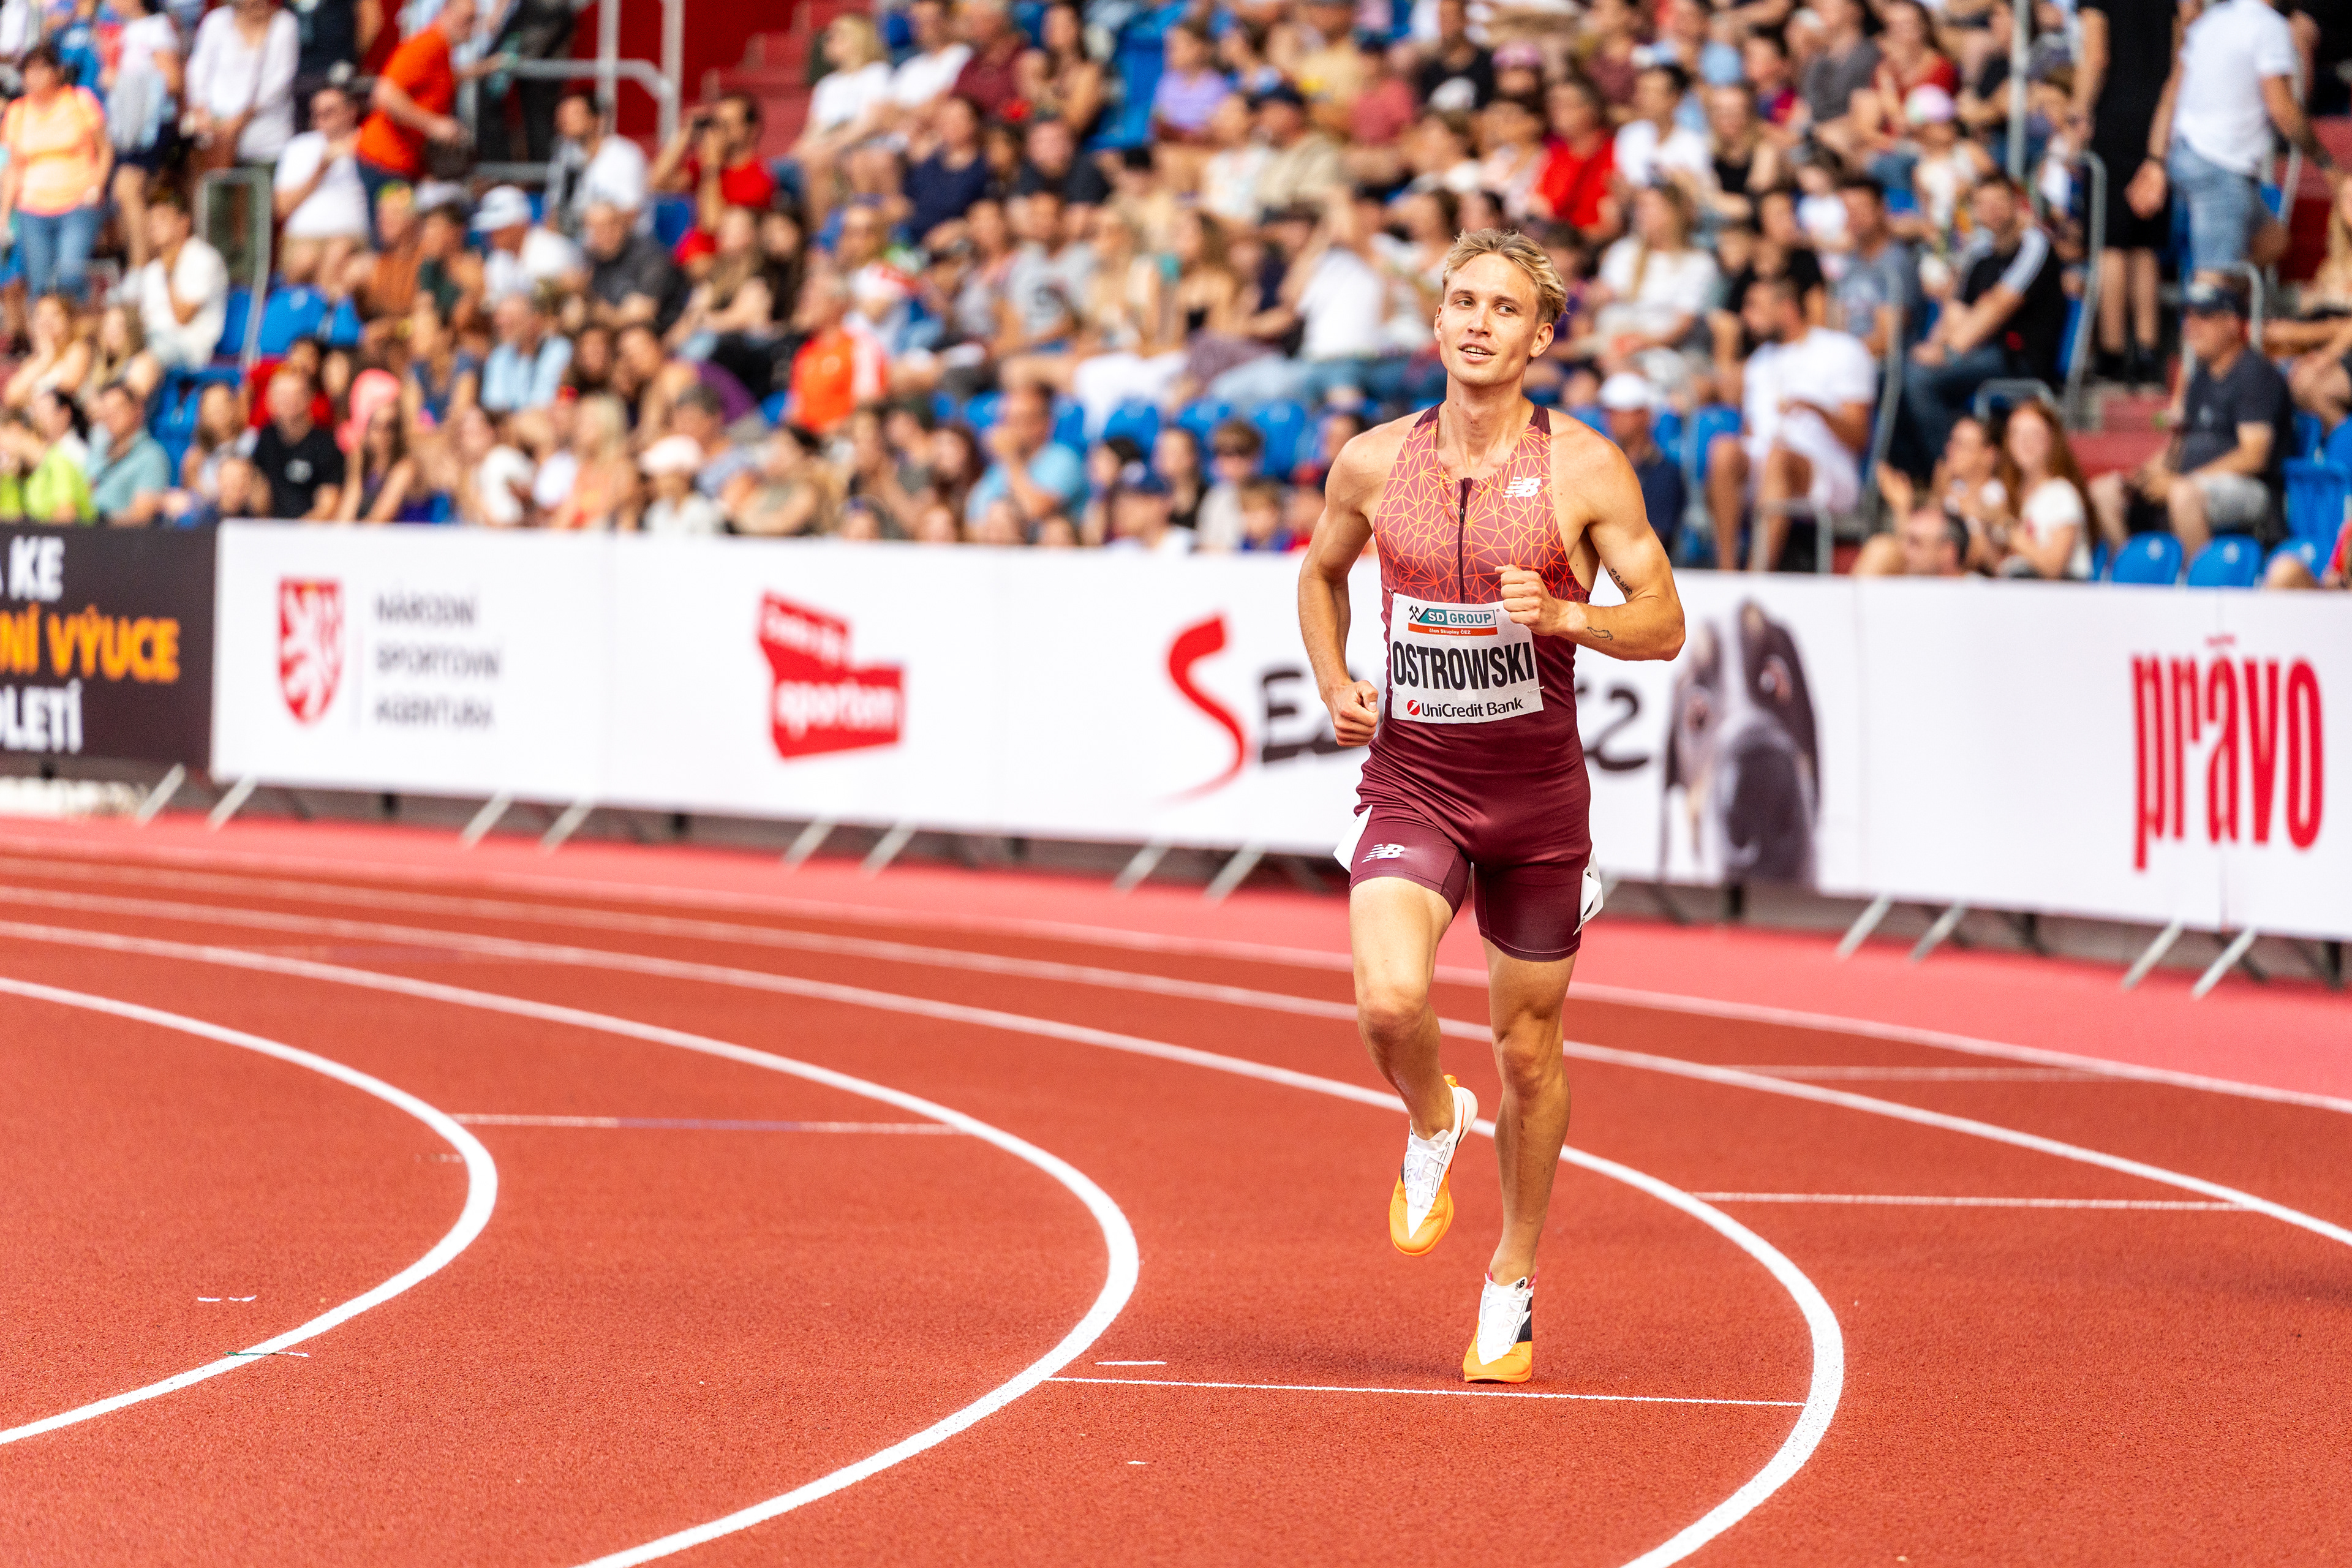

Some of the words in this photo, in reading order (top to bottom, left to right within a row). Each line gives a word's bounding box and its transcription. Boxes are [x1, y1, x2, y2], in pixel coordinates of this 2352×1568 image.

[9, 535, 64, 601] KE
[46, 603, 181, 684] VÝUCE
[1428, 611, 1445, 622] SD
[1449, 612, 1491, 624] GROUP
[1392, 641, 1535, 690] OSTROWSKI
[0, 677, 84, 755] LETÍ
[1422, 703, 1484, 717] UniCredit
[1486, 697, 1524, 716] Bank
